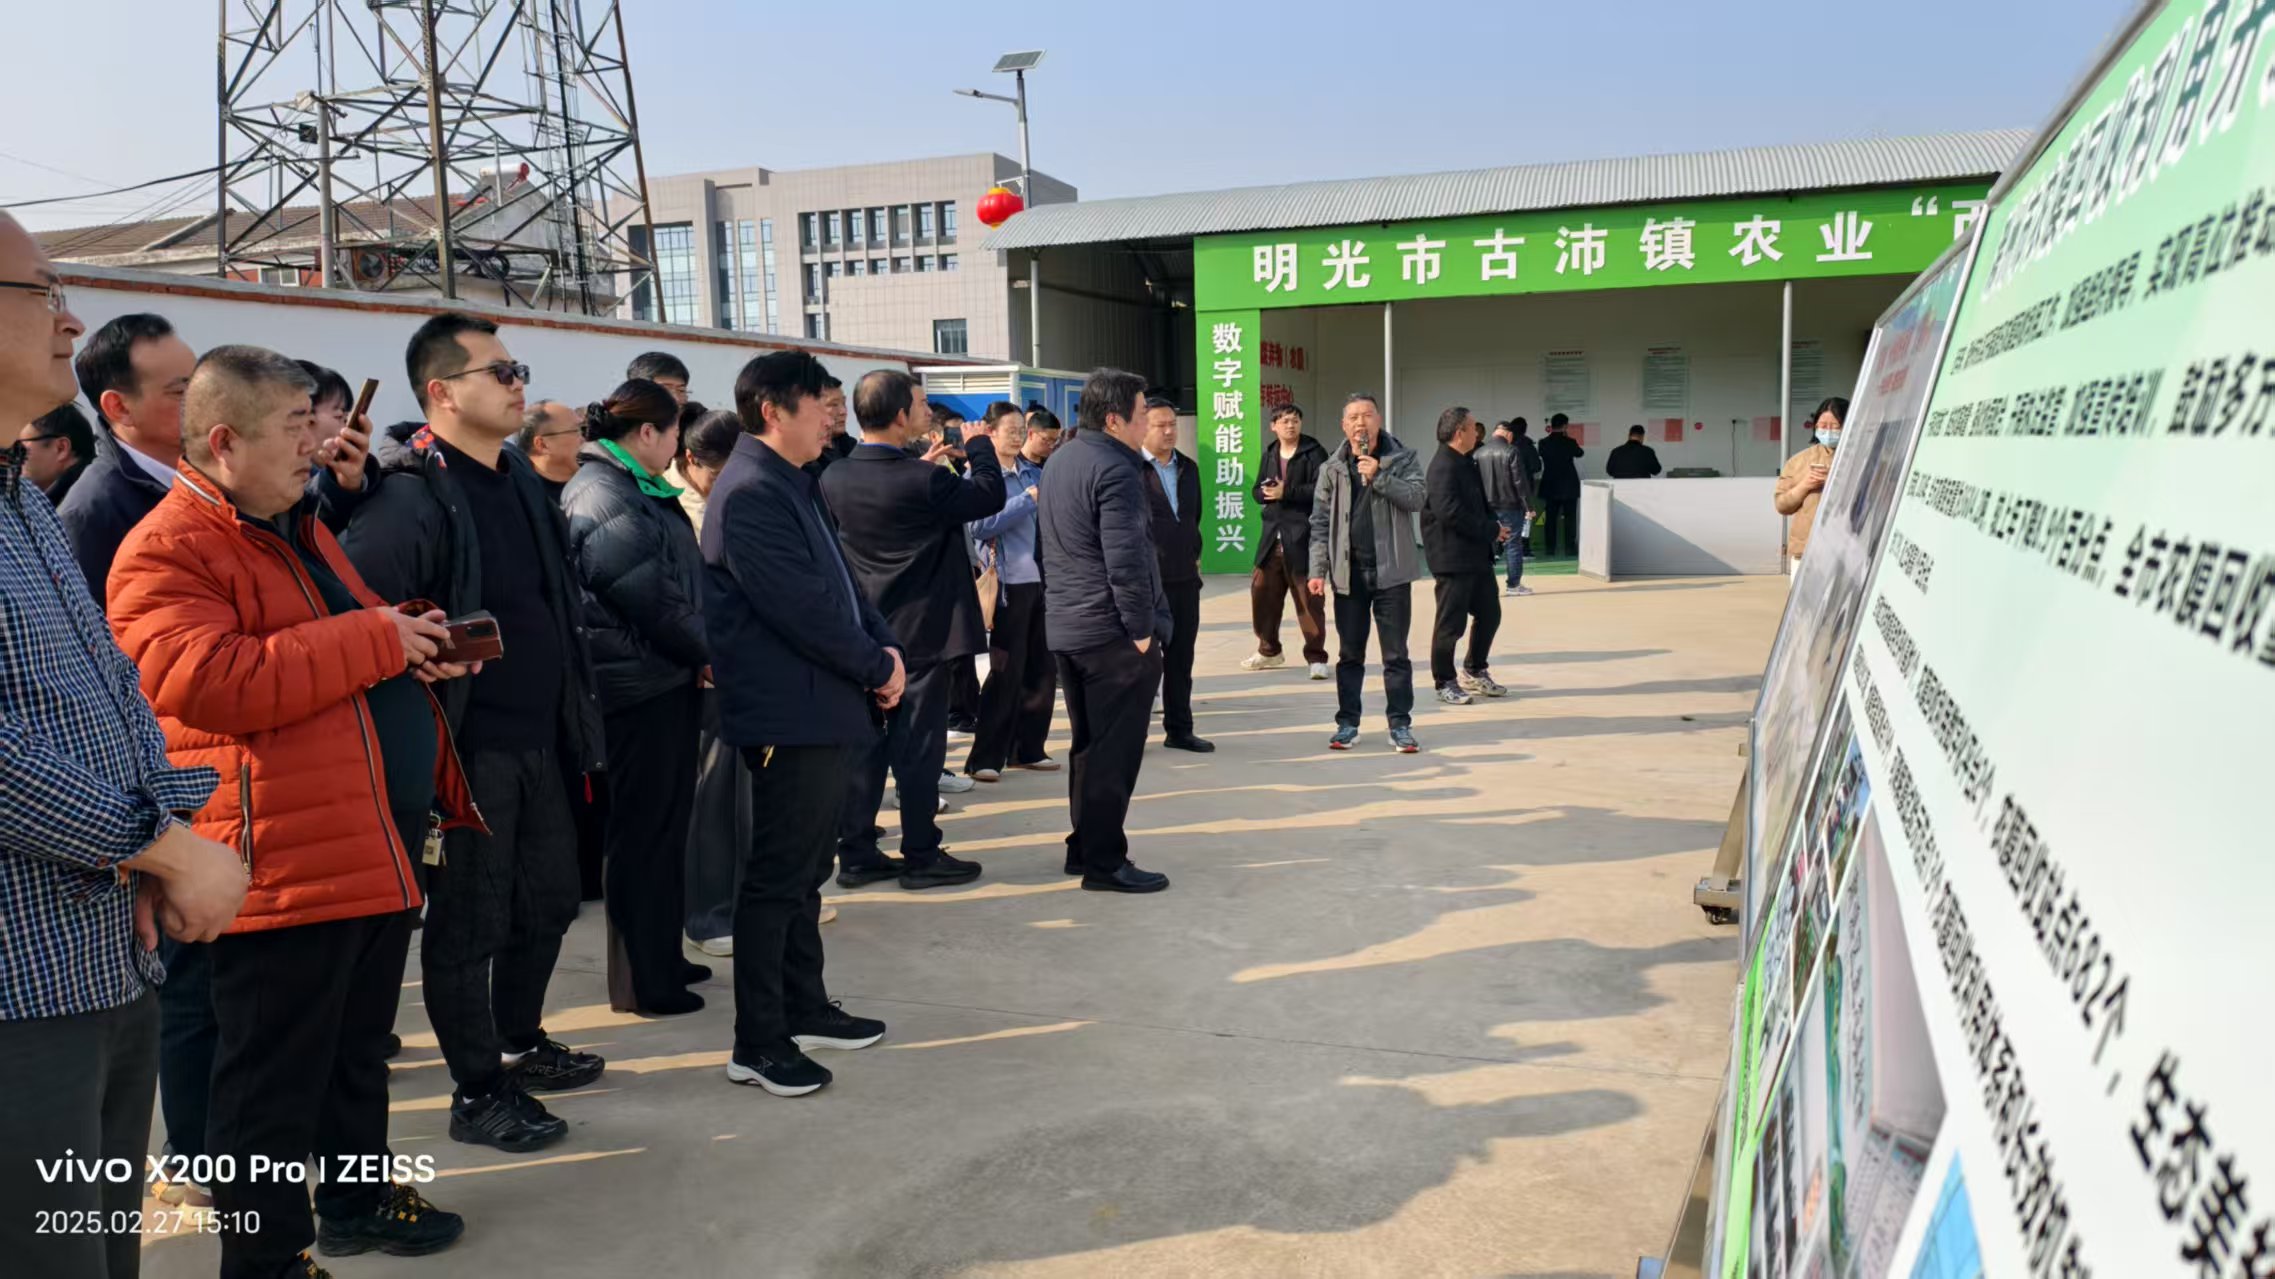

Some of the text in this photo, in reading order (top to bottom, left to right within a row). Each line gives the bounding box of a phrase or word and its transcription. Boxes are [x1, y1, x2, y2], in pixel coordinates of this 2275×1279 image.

[1212, 321, 1246, 554] 数字赋能助振兴
